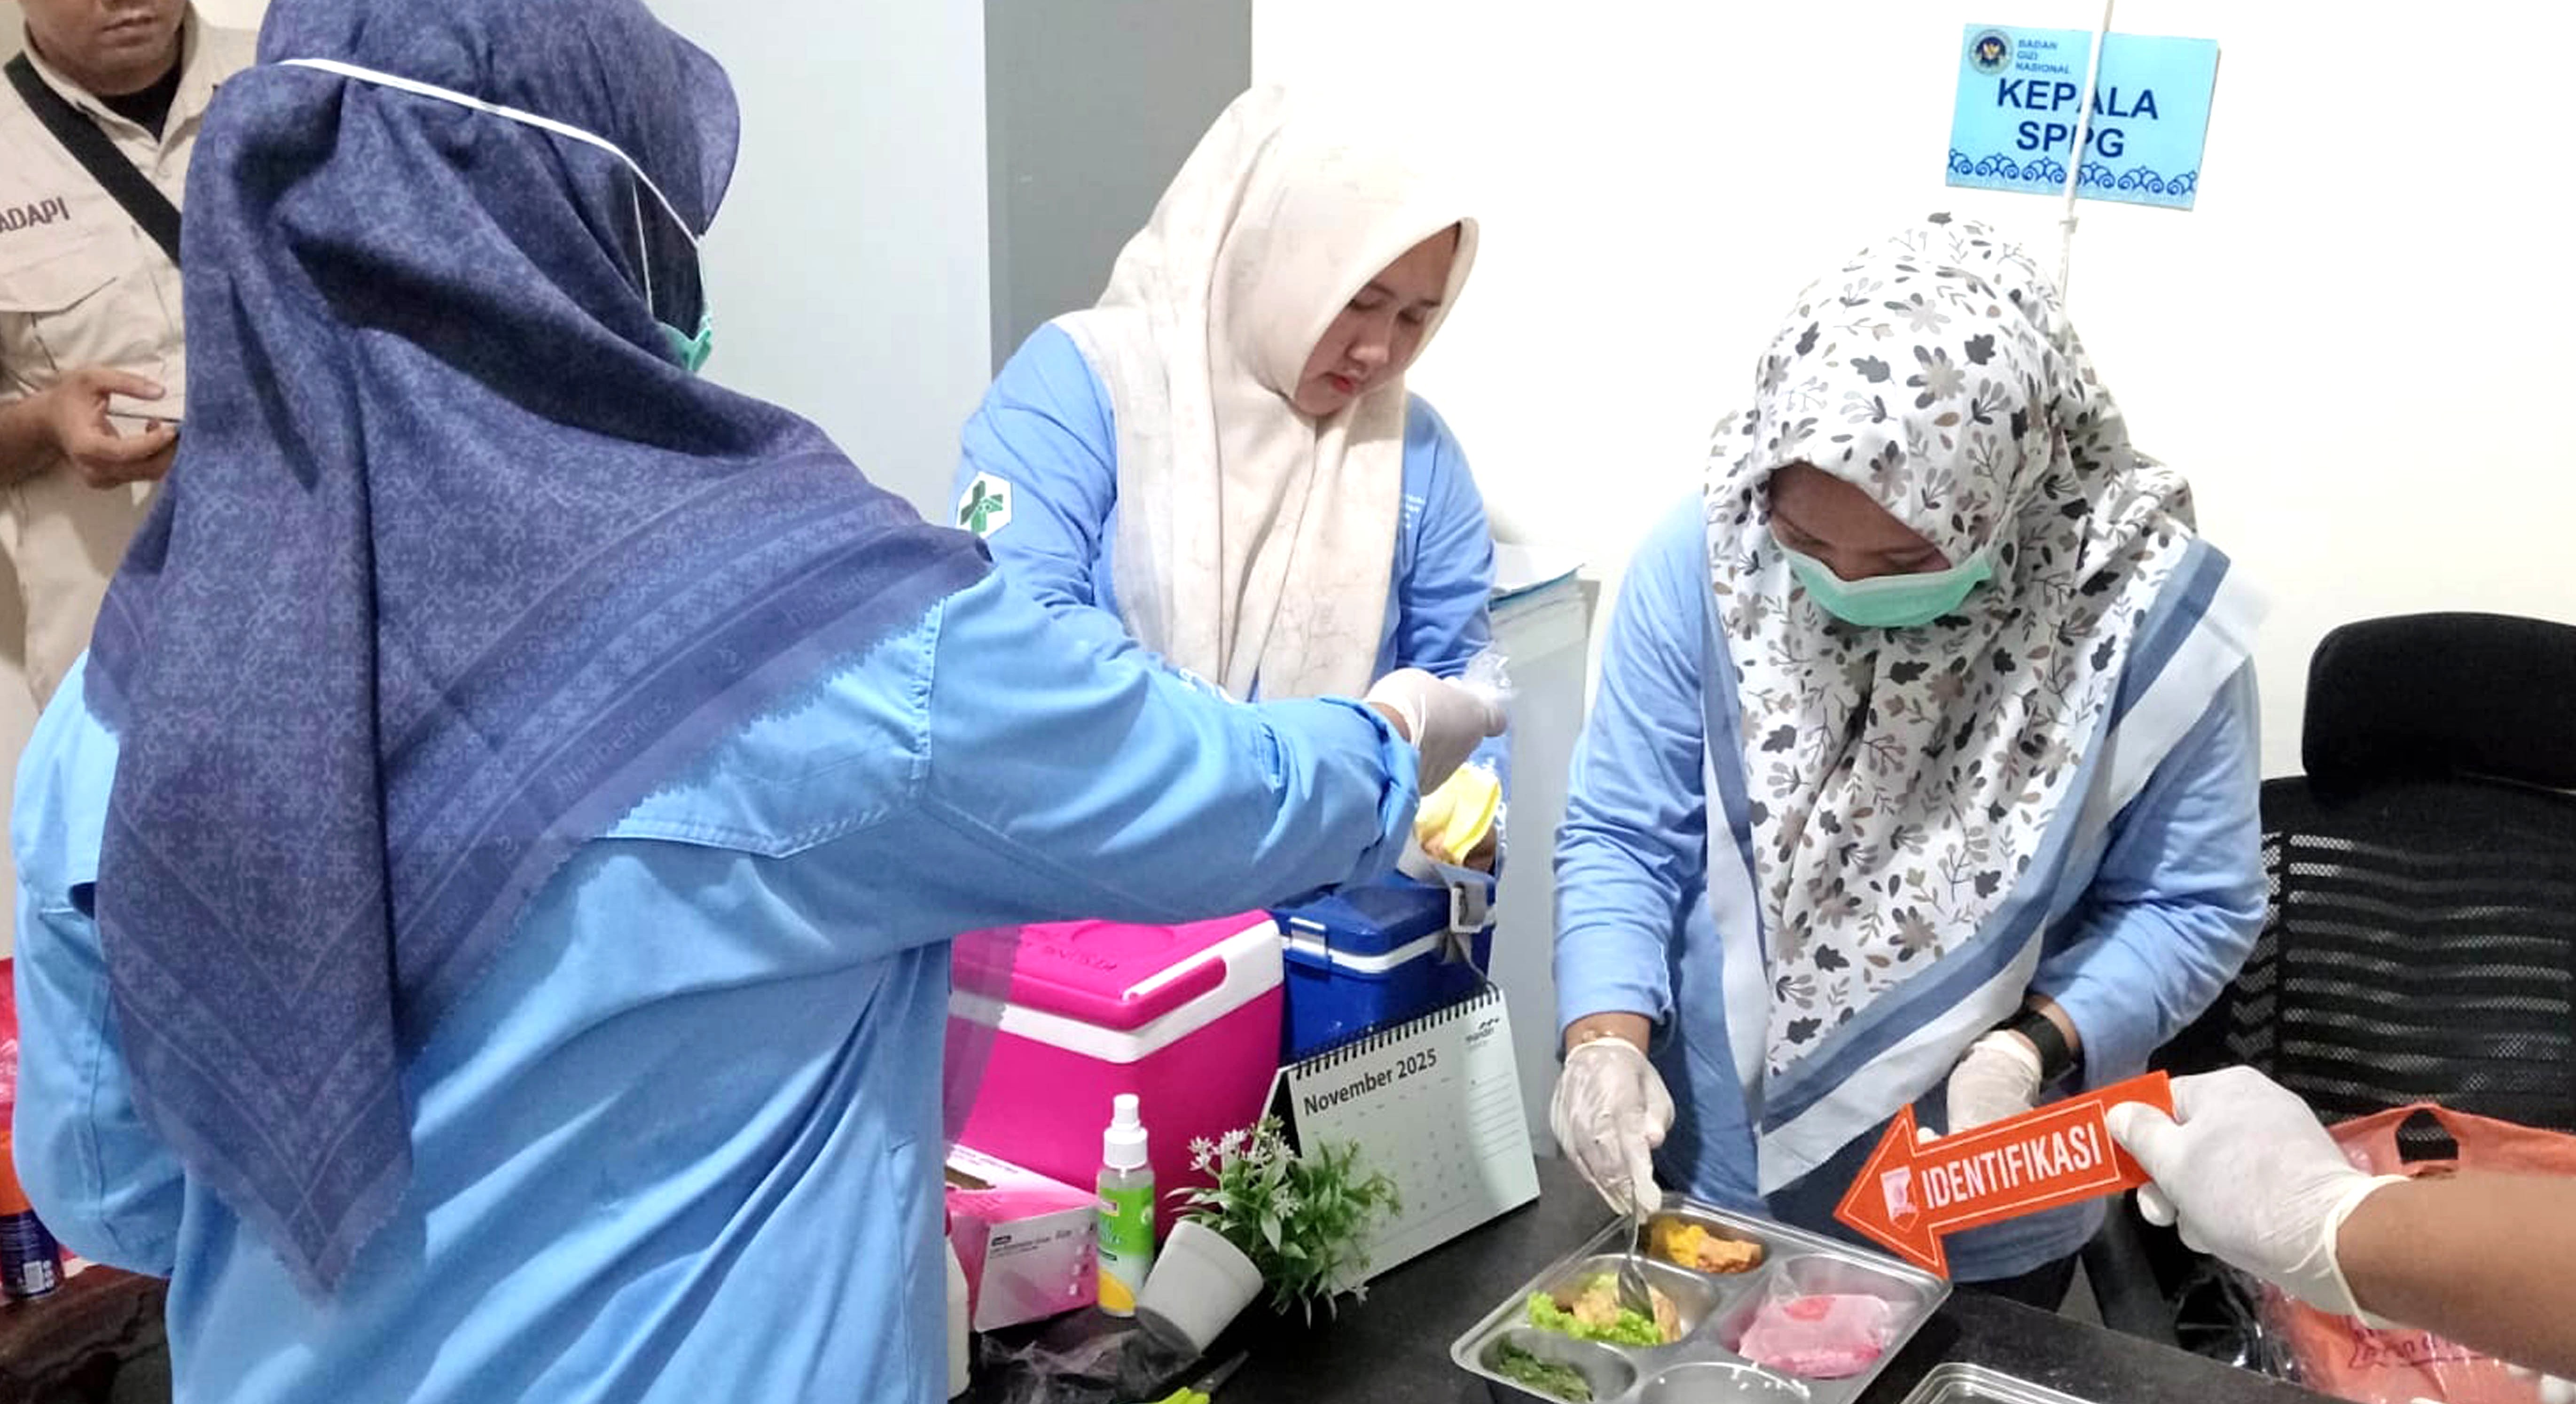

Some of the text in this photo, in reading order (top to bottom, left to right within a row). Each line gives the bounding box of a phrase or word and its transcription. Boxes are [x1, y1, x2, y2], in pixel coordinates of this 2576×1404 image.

[2018, 39, 2058, 50] BADAN
[2017, 51, 2038, 60] GIZI
[2015, 61, 2072, 75] NASIONAL
[1303, 1048, 1437, 1116] November 2025
[1922, 1122, 2102, 1209] IDENTIFIKASI
